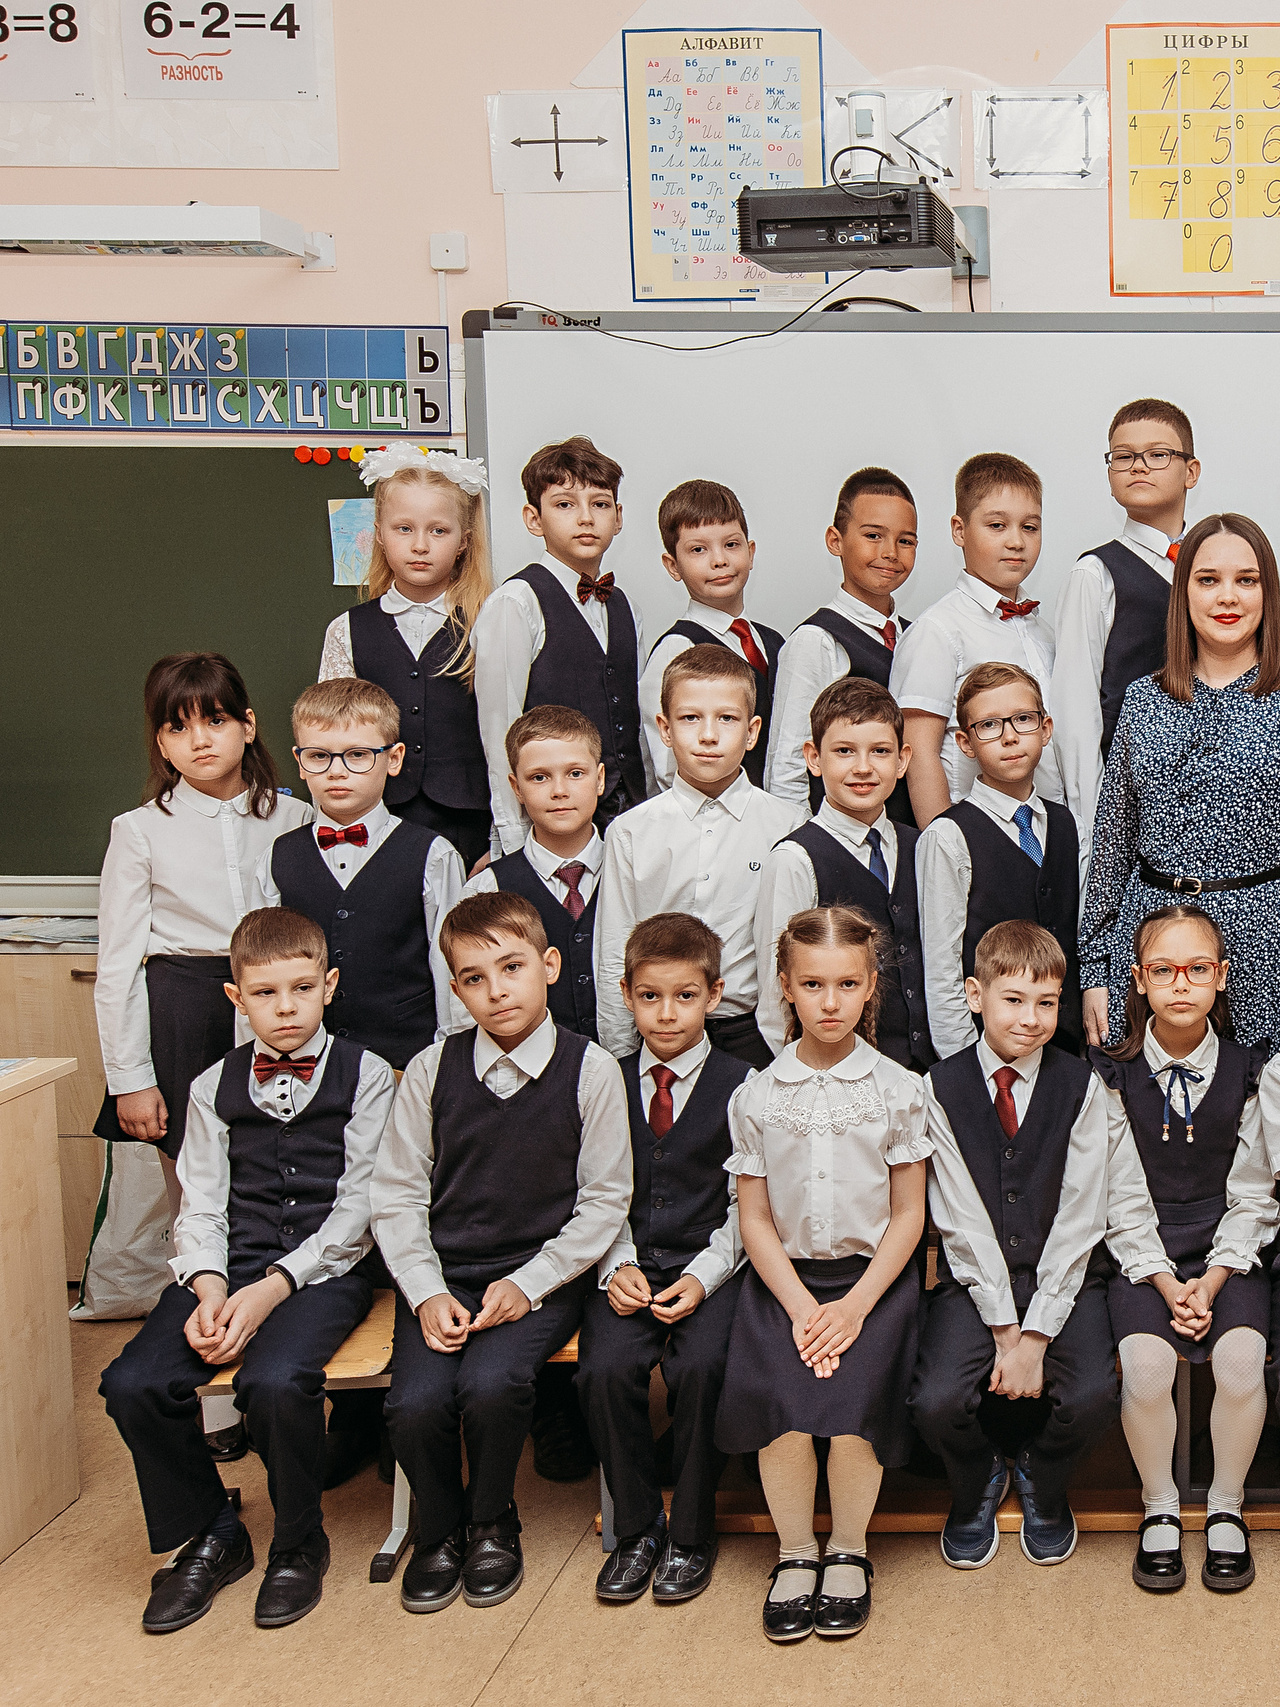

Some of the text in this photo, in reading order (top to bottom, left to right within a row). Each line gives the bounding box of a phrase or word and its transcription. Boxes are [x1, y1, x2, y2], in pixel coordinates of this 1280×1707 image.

[0, 1, 78, 43] =8
[143, 0, 301, 39] 6-2=4
[680, 37, 764, 50] АЛФАВИТ
[1163, 34, 1249, 50] ЦИФРЫ
[161, 65, 223, 81] РАЗНОСТЬ
[1128, 59, 1244, 75] 1 2 3
[1162, 70, 1177, 110] 1
[1210, 71, 1231, 109] 2
[1129, 114, 1244, 129] 4 5 6
[1160, 126, 1178, 165] 4
[1210, 126, 1231, 164] 5
[1130, 170, 1245, 185] 7 8 9
[653, 202, 708, 210] Уу Фф
[1160, 181, 1178, 219] 7
[1209, 181, 1231, 219] 8
